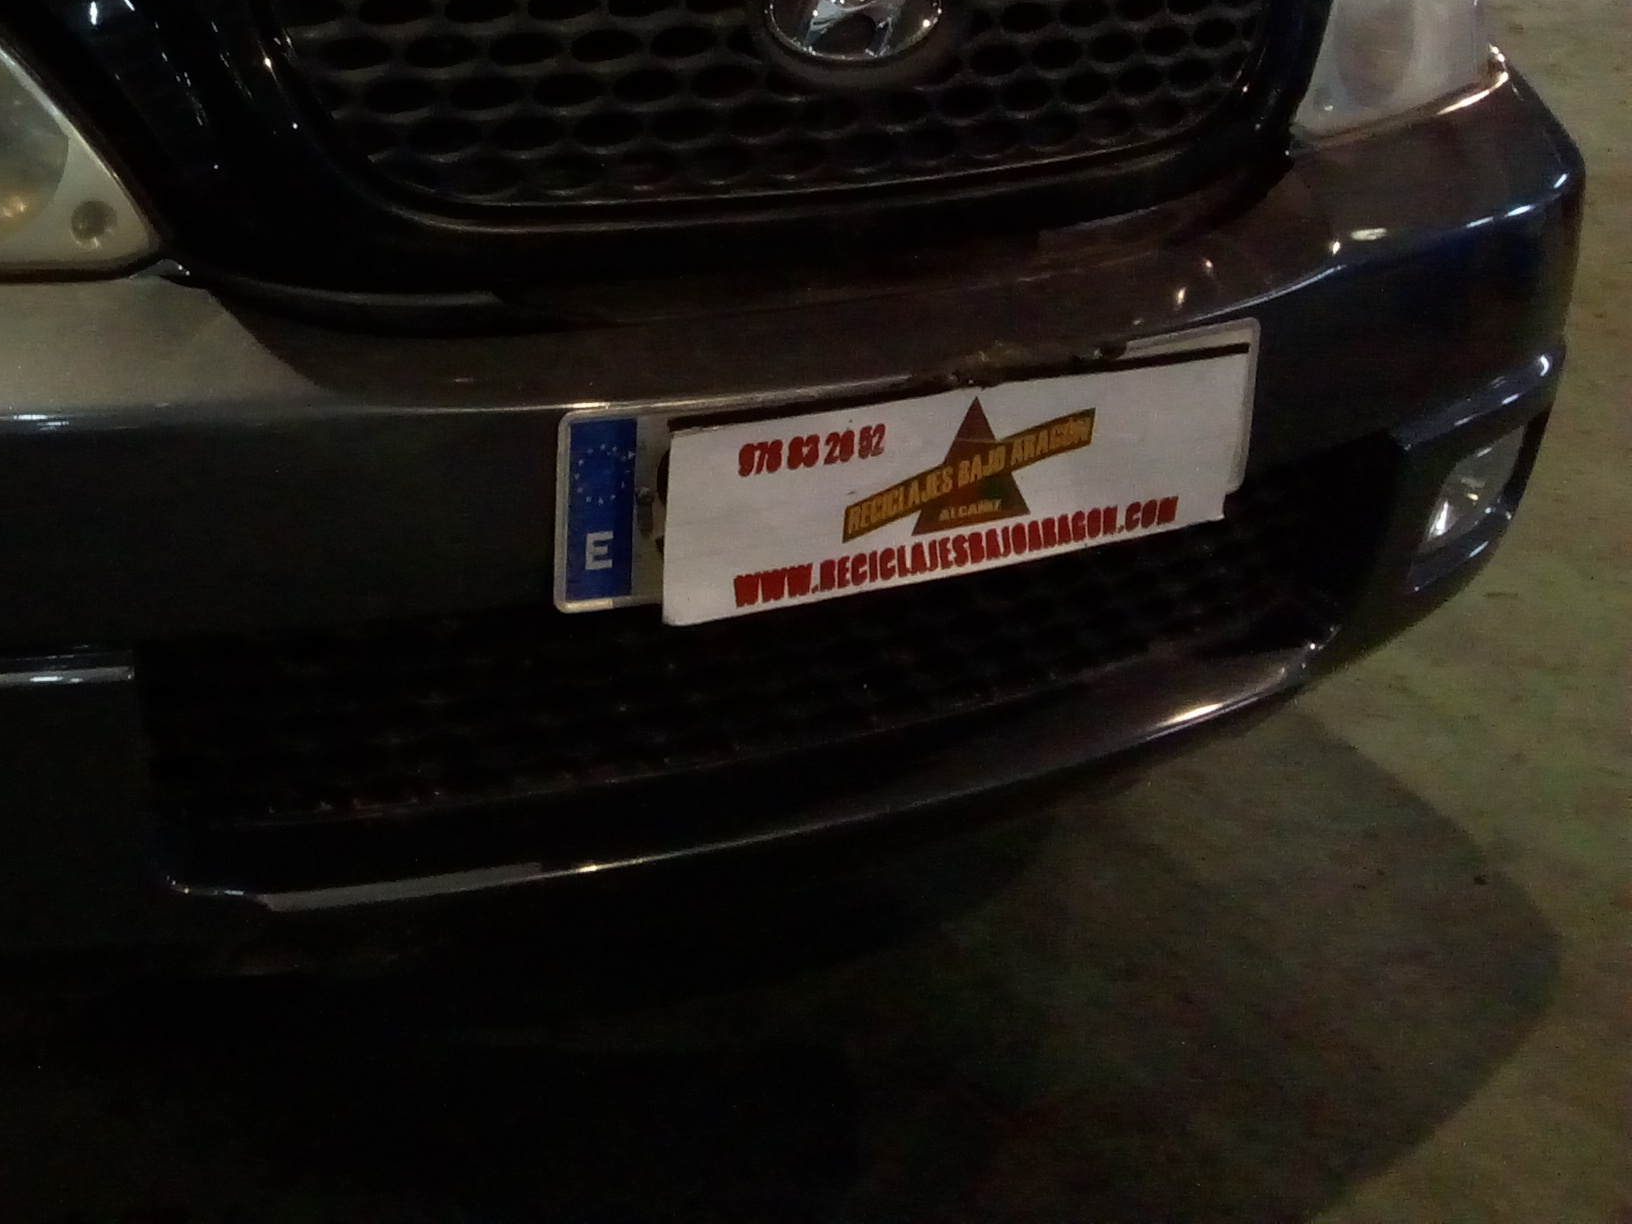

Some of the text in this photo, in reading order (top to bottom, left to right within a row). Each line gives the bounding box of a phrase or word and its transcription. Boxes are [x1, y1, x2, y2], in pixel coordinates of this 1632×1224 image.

[738, 438, 783, 477] 978
[787, 434, 820, 470] 83
[858, 423, 885, 460] 52
[847, 466, 954, 535] RECICLAJES
[958, 445, 1007, 489] BAJO
[585, 531, 614, 571] E
